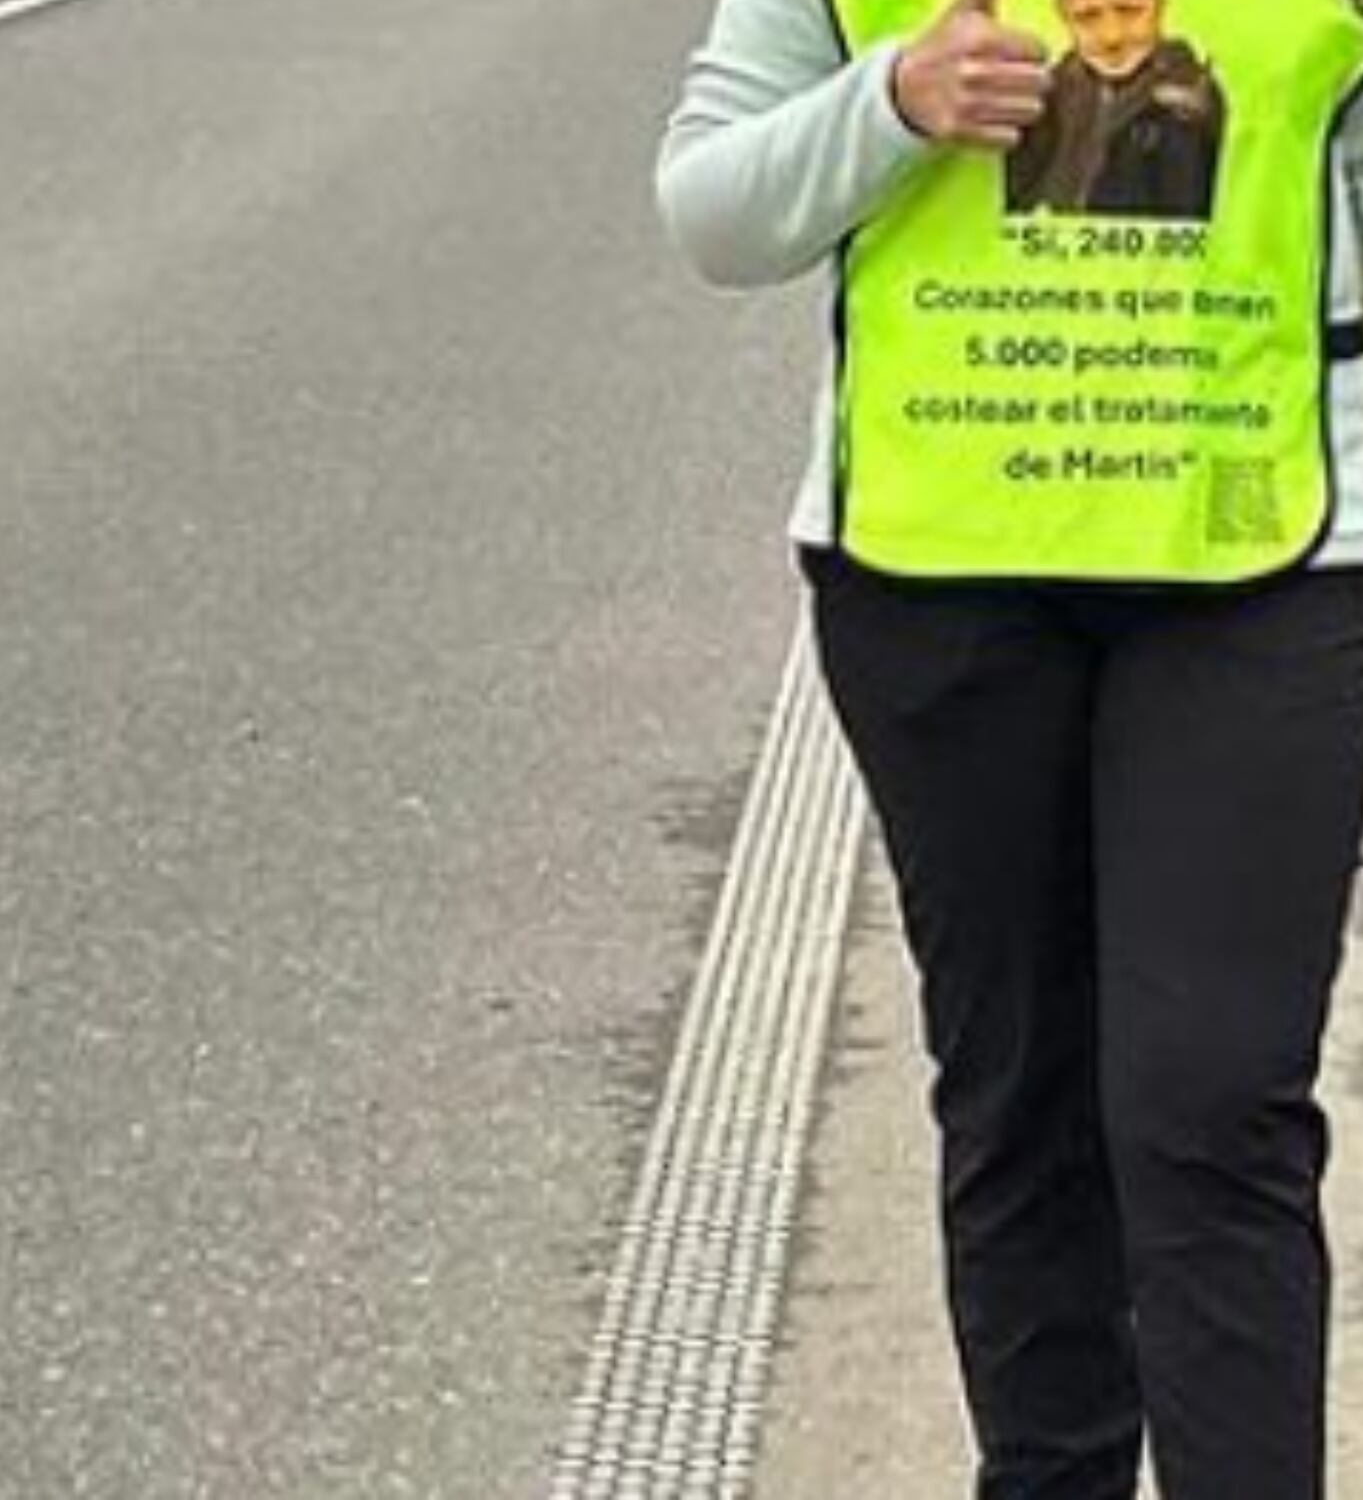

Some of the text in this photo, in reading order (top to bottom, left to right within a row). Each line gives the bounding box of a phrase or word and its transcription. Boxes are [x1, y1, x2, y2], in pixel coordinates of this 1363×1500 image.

[912, 279, 1106, 314] Corazones
[1112, 287, 1184, 320] que
[963, 336, 1067, 368] 5.000
[902, 395, 1039, 424] costear
[1047, 394, 1086, 423] el
[1002, 449, 1053, 480] de
